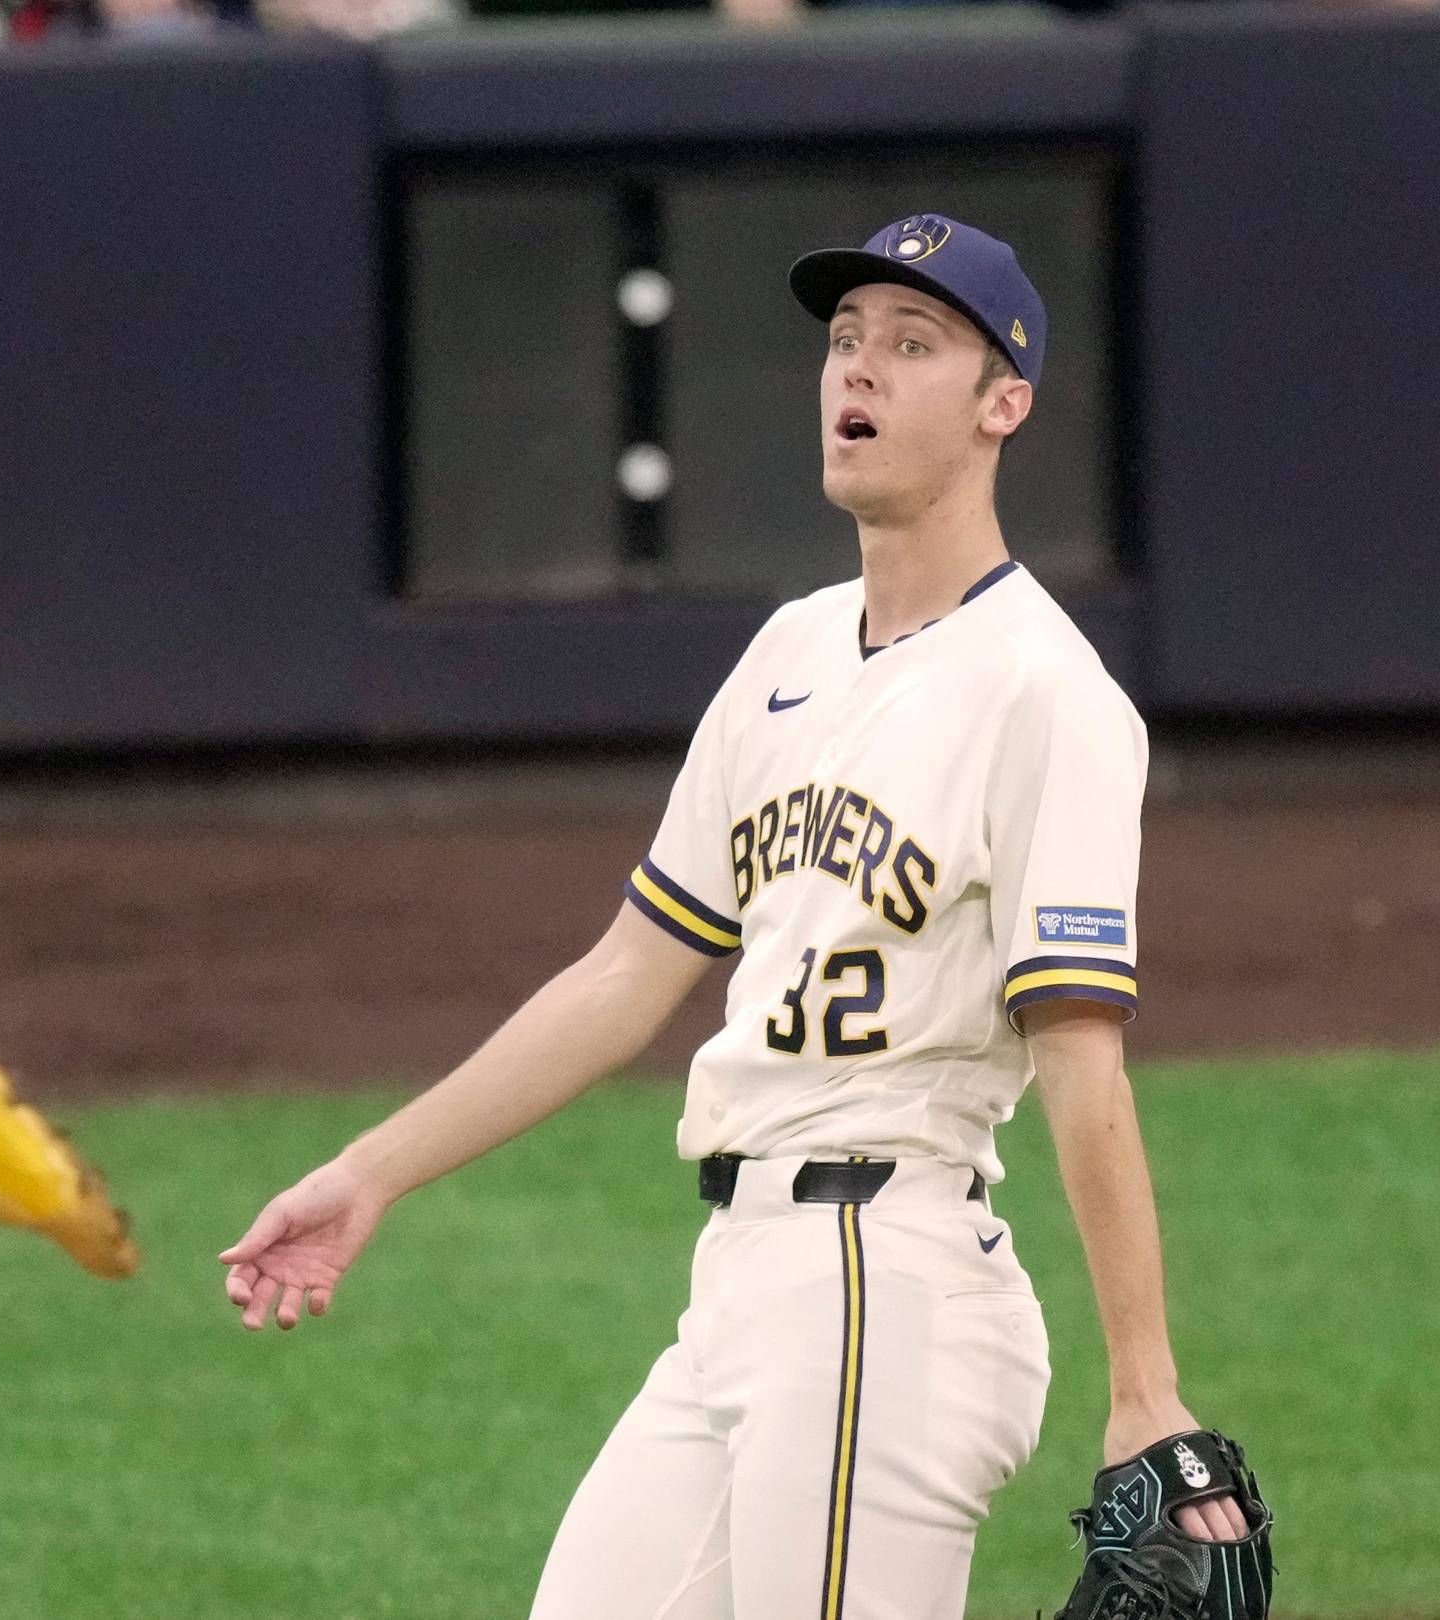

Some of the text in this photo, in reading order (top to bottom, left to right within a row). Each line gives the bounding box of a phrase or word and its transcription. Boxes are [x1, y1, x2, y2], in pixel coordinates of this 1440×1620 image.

[730, 781, 939, 937] BREWERS
[1062, 913, 1125, 928] Northwestern
[1063, 924, 1100, 936] Mutual
[764, 946, 891, 1060] 32
